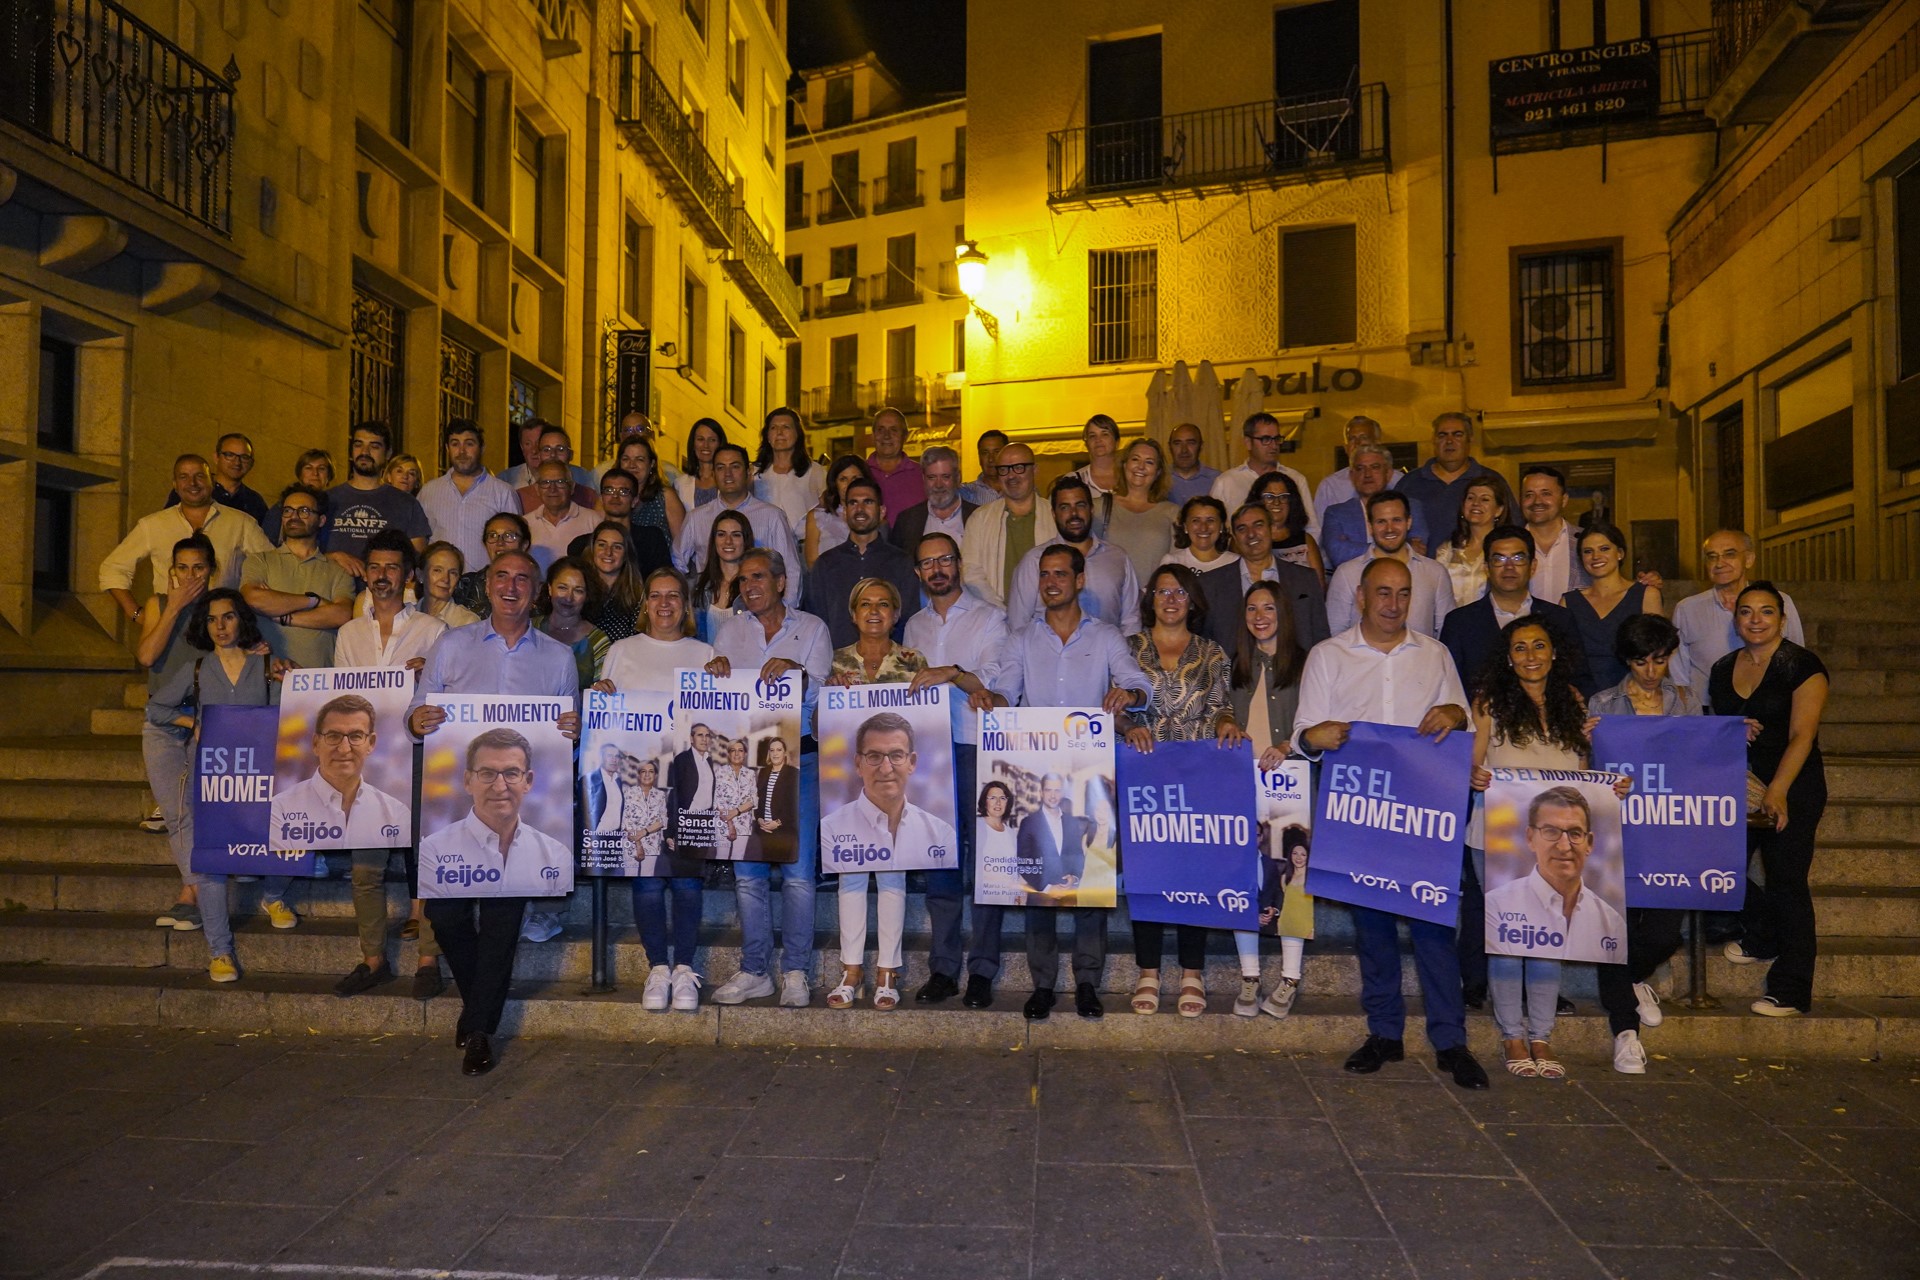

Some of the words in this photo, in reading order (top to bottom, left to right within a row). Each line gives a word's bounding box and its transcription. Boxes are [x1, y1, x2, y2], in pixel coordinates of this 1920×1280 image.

[1498, 52, 1574, 74] CENTRO
[1581, 40, 1651, 62] INGLES
[1557, 64, 1601, 77] FRANCES
[1505, 87, 1583, 107] MATRICULA
[1587, 79, 1648, 94] ABIERTA
[1524, 106, 1553, 122] 921
[1559, 101, 1588, 116] 461
[1594, 96, 1626, 112] 820
[334, 518, 387, 528] BANFF
[292, 674, 310, 692] ES
[313, 672, 329, 691] EL
[333, 670, 405, 690] MOMENTO
[680, 671, 697, 691] ES
[700, 672, 717, 691] EL
[589, 691, 608, 711] ES
[611, 692, 627, 711] EL
[680, 691, 750, 711] MOMENTO
[758, 700, 794, 712] Segovia
[828, 692, 845, 710] ES
[849, 691, 865, 709] EL
[868, 686, 940, 708] MOMENTO
[460, 703, 478, 723] EL
[483, 703, 561, 723] MOMENTO
[588, 711, 662, 732] MOMENTO
[983, 711, 1000, 731] ES
[1005, 712, 1022, 730] EL
[982, 731, 1059, 751] MOMENTO
[201, 747, 229, 774] ES
[234, 747, 260, 774] EL
[1329, 763, 1362, 794] ES
[1367, 768, 1396, 800] EL
[1493, 767, 1514, 782] ES
[1516, 768, 1537, 782] EL
[1642, 763, 1673, 793] EL
[1127, 785, 1158, 814] ES
[1163, 783, 1193, 812] EL
[1264, 790, 1302, 801] Segovia
[282, 812, 309, 821] VOTA
[678, 807, 720, 816] Candidatura
[1326, 792, 1456, 842] MOMENTO
[582, 828, 628, 836] Candidatura
[678, 816, 728, 828] Senado:
[1129, 813, 1249, 846] MOMENTO
[281, 822, 343, 844] feijóo
[582, 836, 636, 849] Senado:
[832, 834, 858, 843] VOTA
[227, 843, 268, 857] VOTA
[435, 854, 465, 864] VOTA
[832, 844, 891, 866] feijóo
[983, 856, 1034, 864] Candidatura
[1035, 856, 1043, 864] al
[435, 864, 501, 887] feijóo
[983, 863, 1043, 875] Congreso:
[1349, 871, 1401, 893] VOTA
[1638, 872, 1692, 888] VOTA
[1161, 890, 1211, 906] VOTA
[1498, 911, 1528, 923] VOTA
[1497, 923, 1564, 950] feijóo
